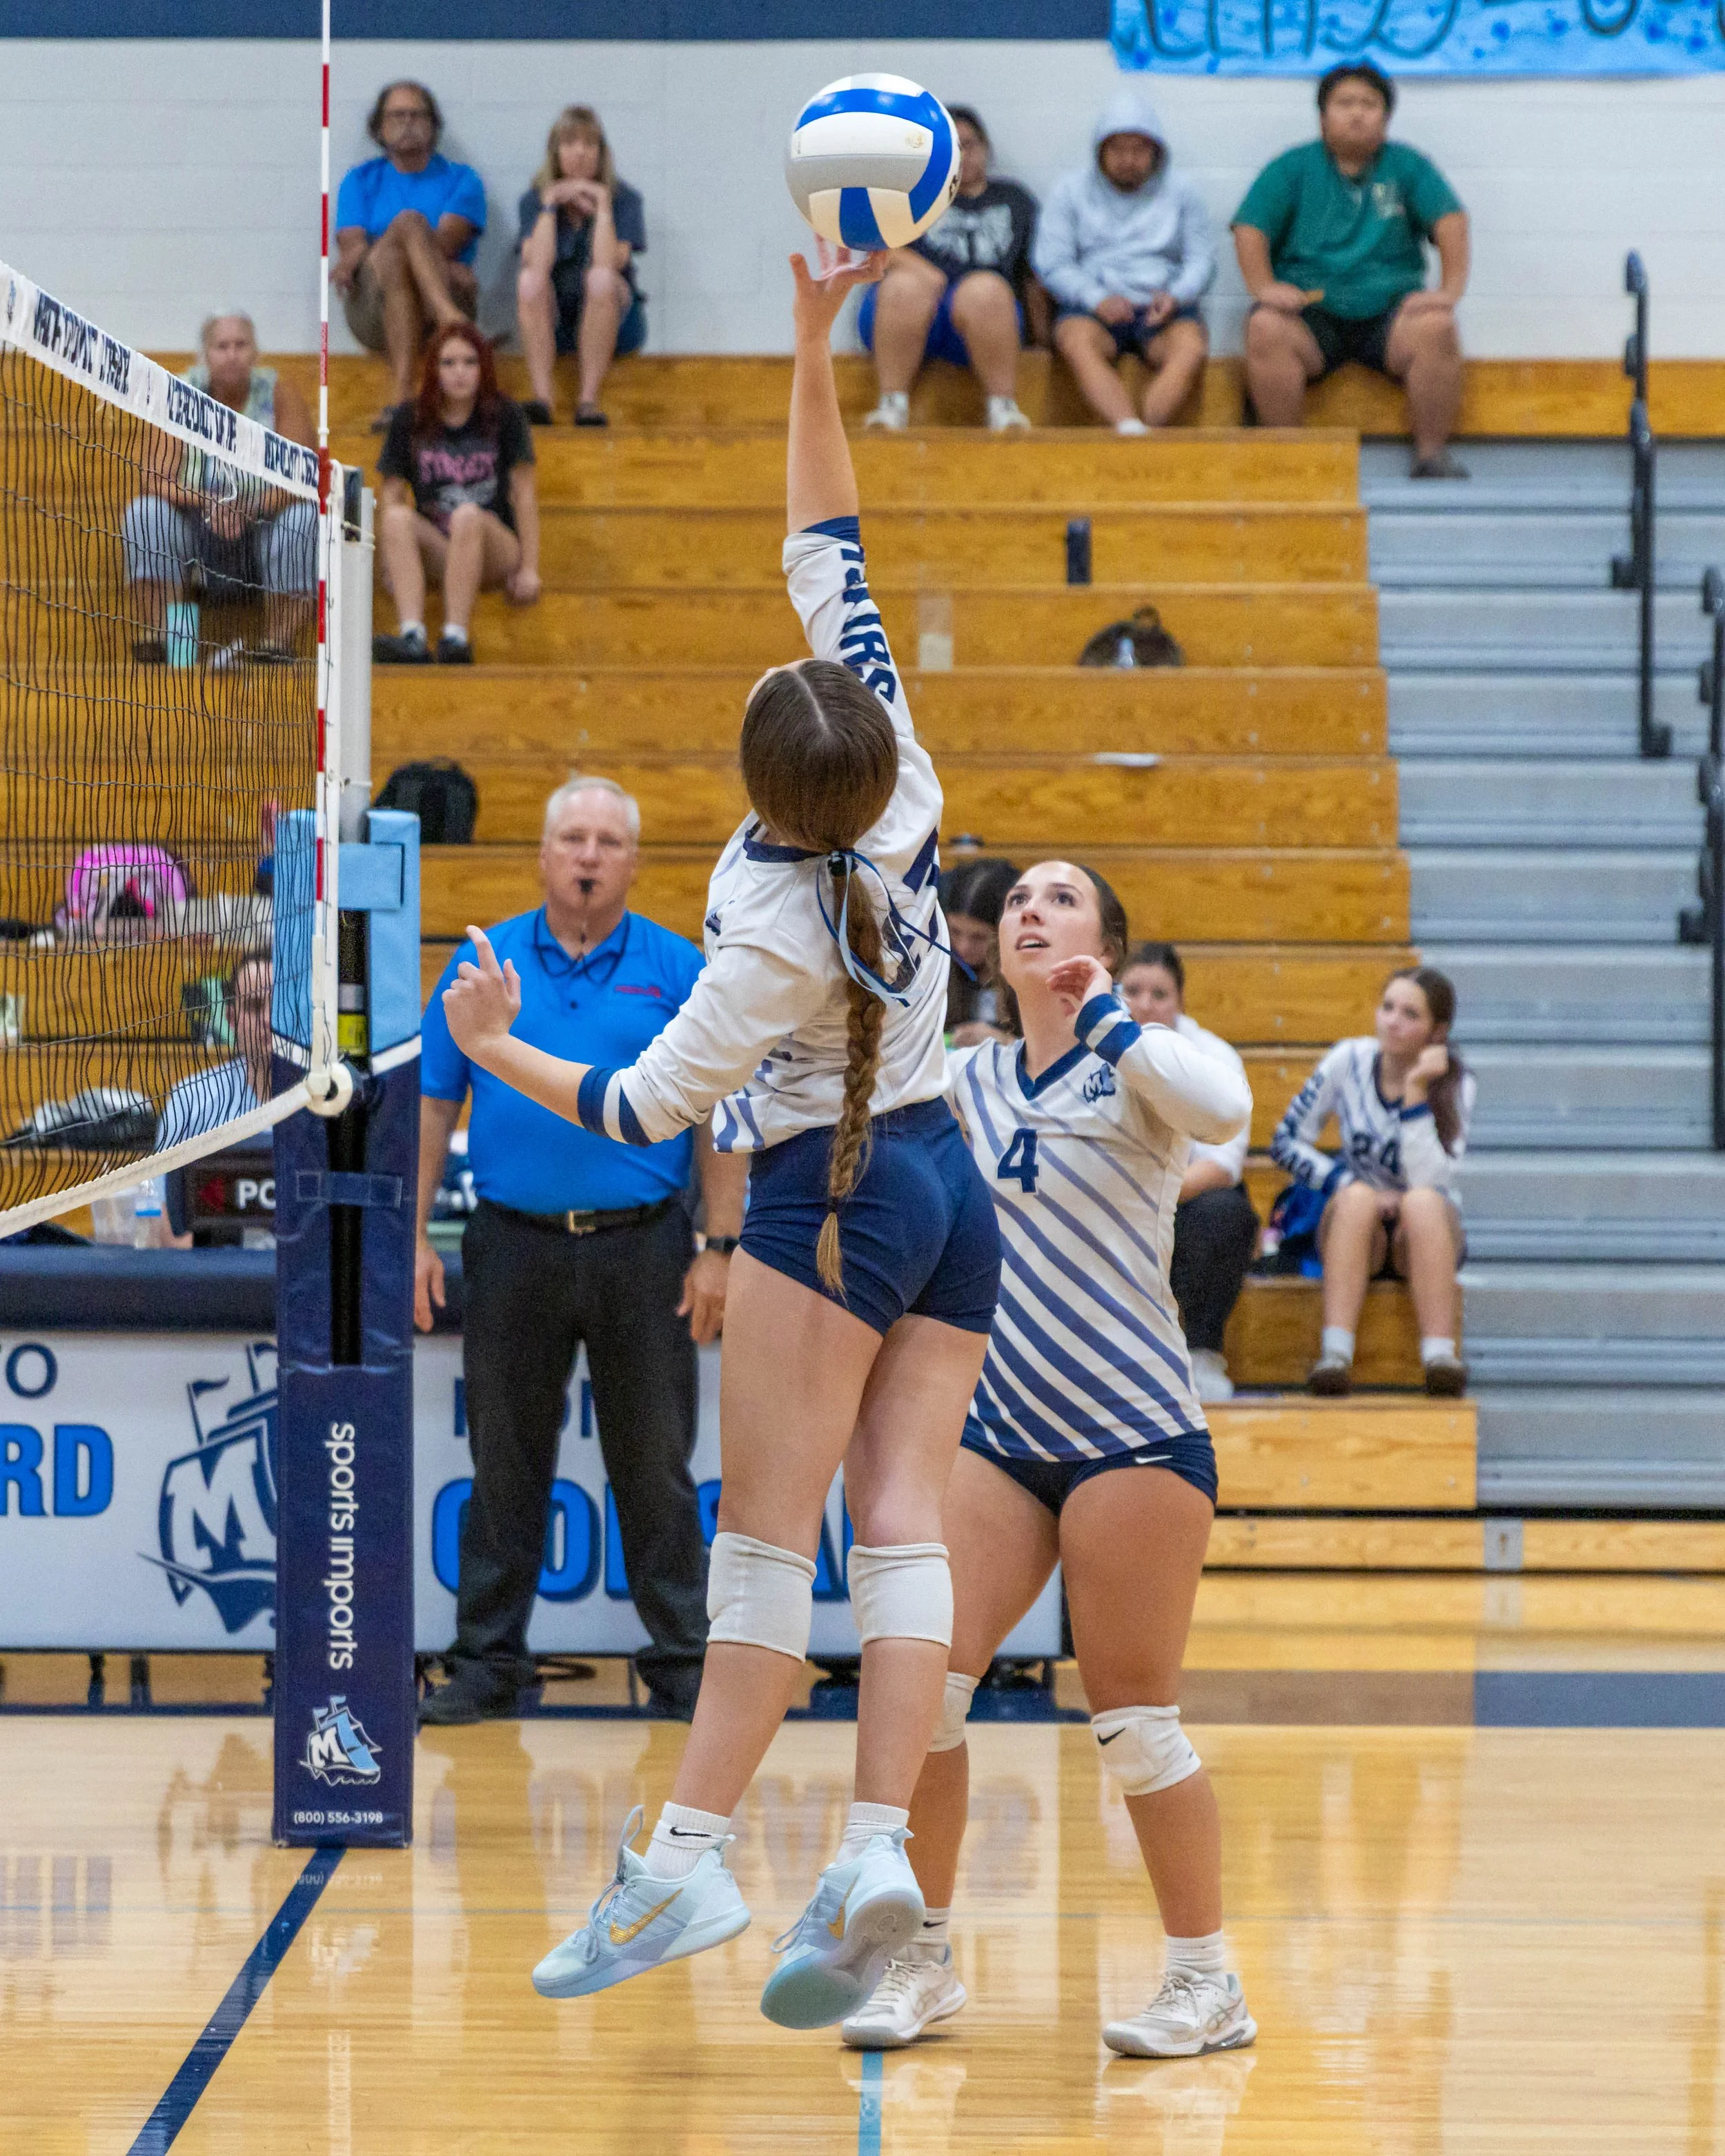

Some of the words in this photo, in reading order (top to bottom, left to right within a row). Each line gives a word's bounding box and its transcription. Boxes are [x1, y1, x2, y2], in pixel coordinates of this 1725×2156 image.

[997, 1127, 1039, 1194] 4
[1352, 1131, 1401, 1176] 24
[0, 1342, 58, 1399] O
[0, 1423, 115, 1517] RD
[324, 1422, 359, 1532] sports
[324, 1537, 359, 1670] imports
[294, 1811, 324, 1825] (800)
[327, 1811, 384, 1824] 556-3198
